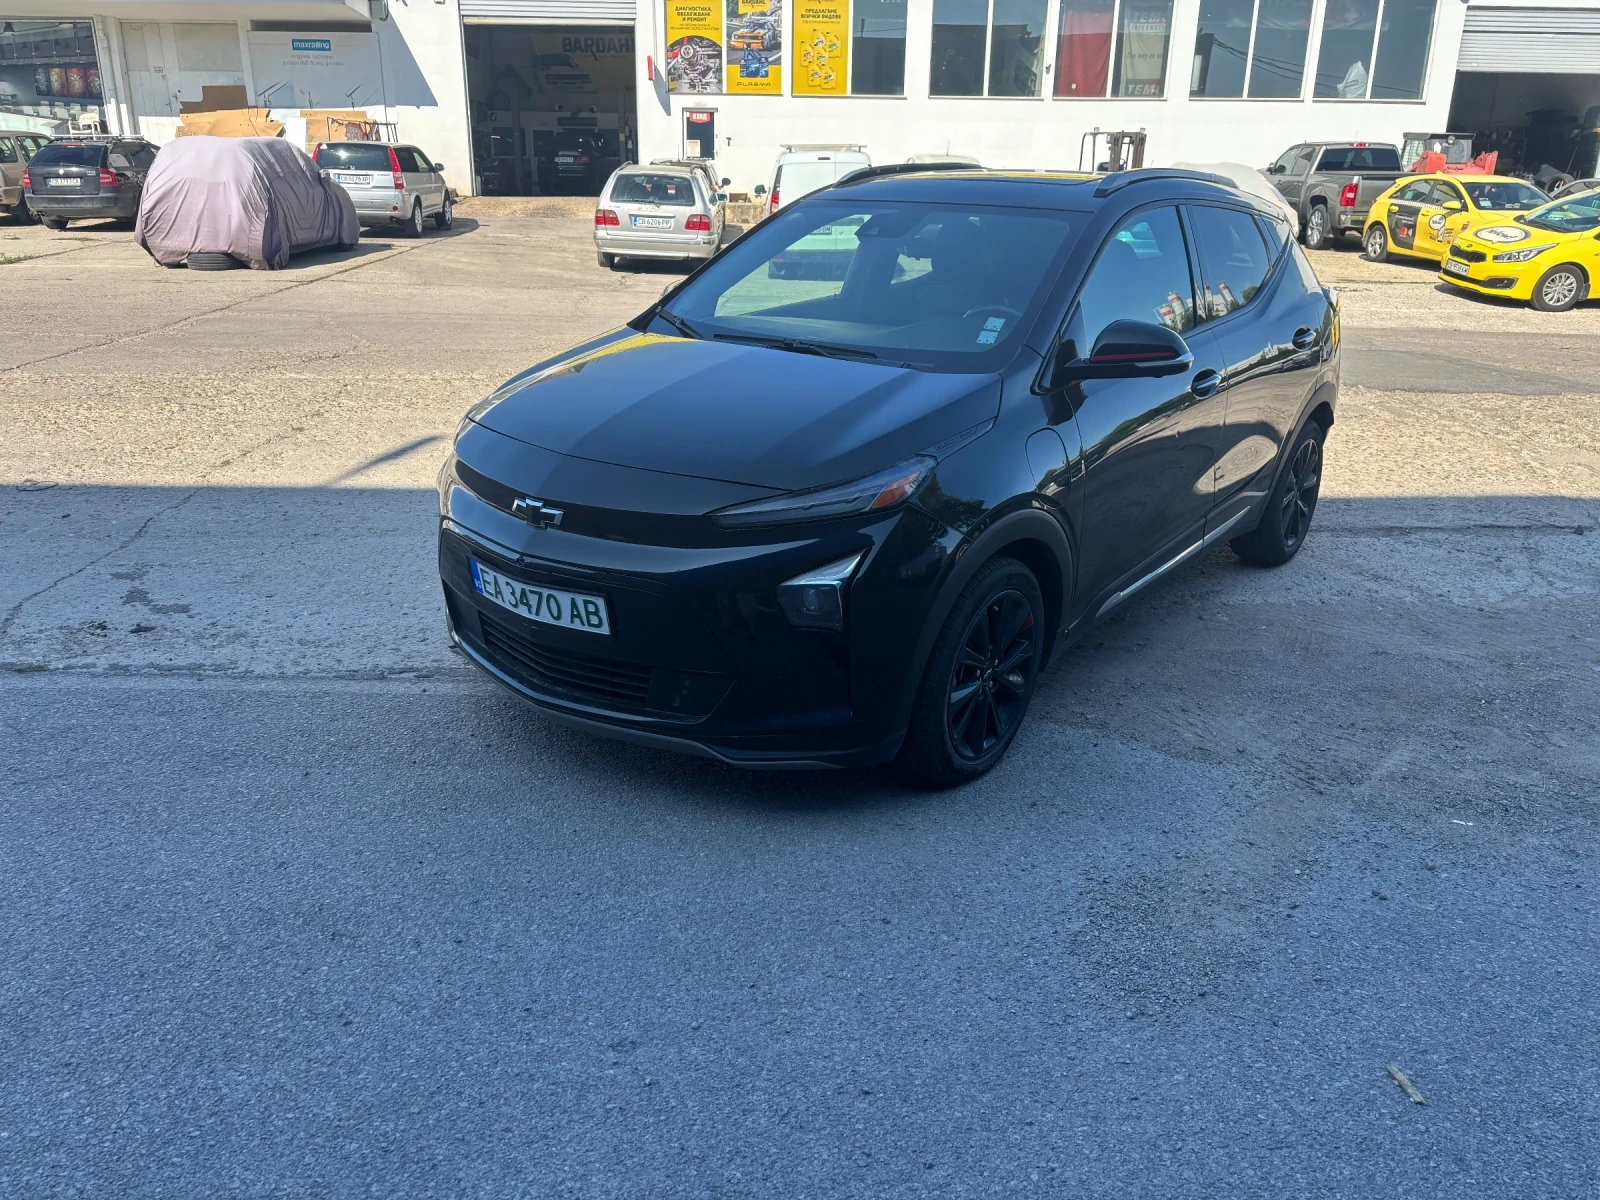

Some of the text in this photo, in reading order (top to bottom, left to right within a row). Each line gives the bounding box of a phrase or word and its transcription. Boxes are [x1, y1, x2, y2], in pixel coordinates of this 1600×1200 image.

[293, 41, 330, 50] maxrailing
[637, 217, 670, 226] CB 6206 PP
[480, 566, 603, 629] EA 3470 AB
